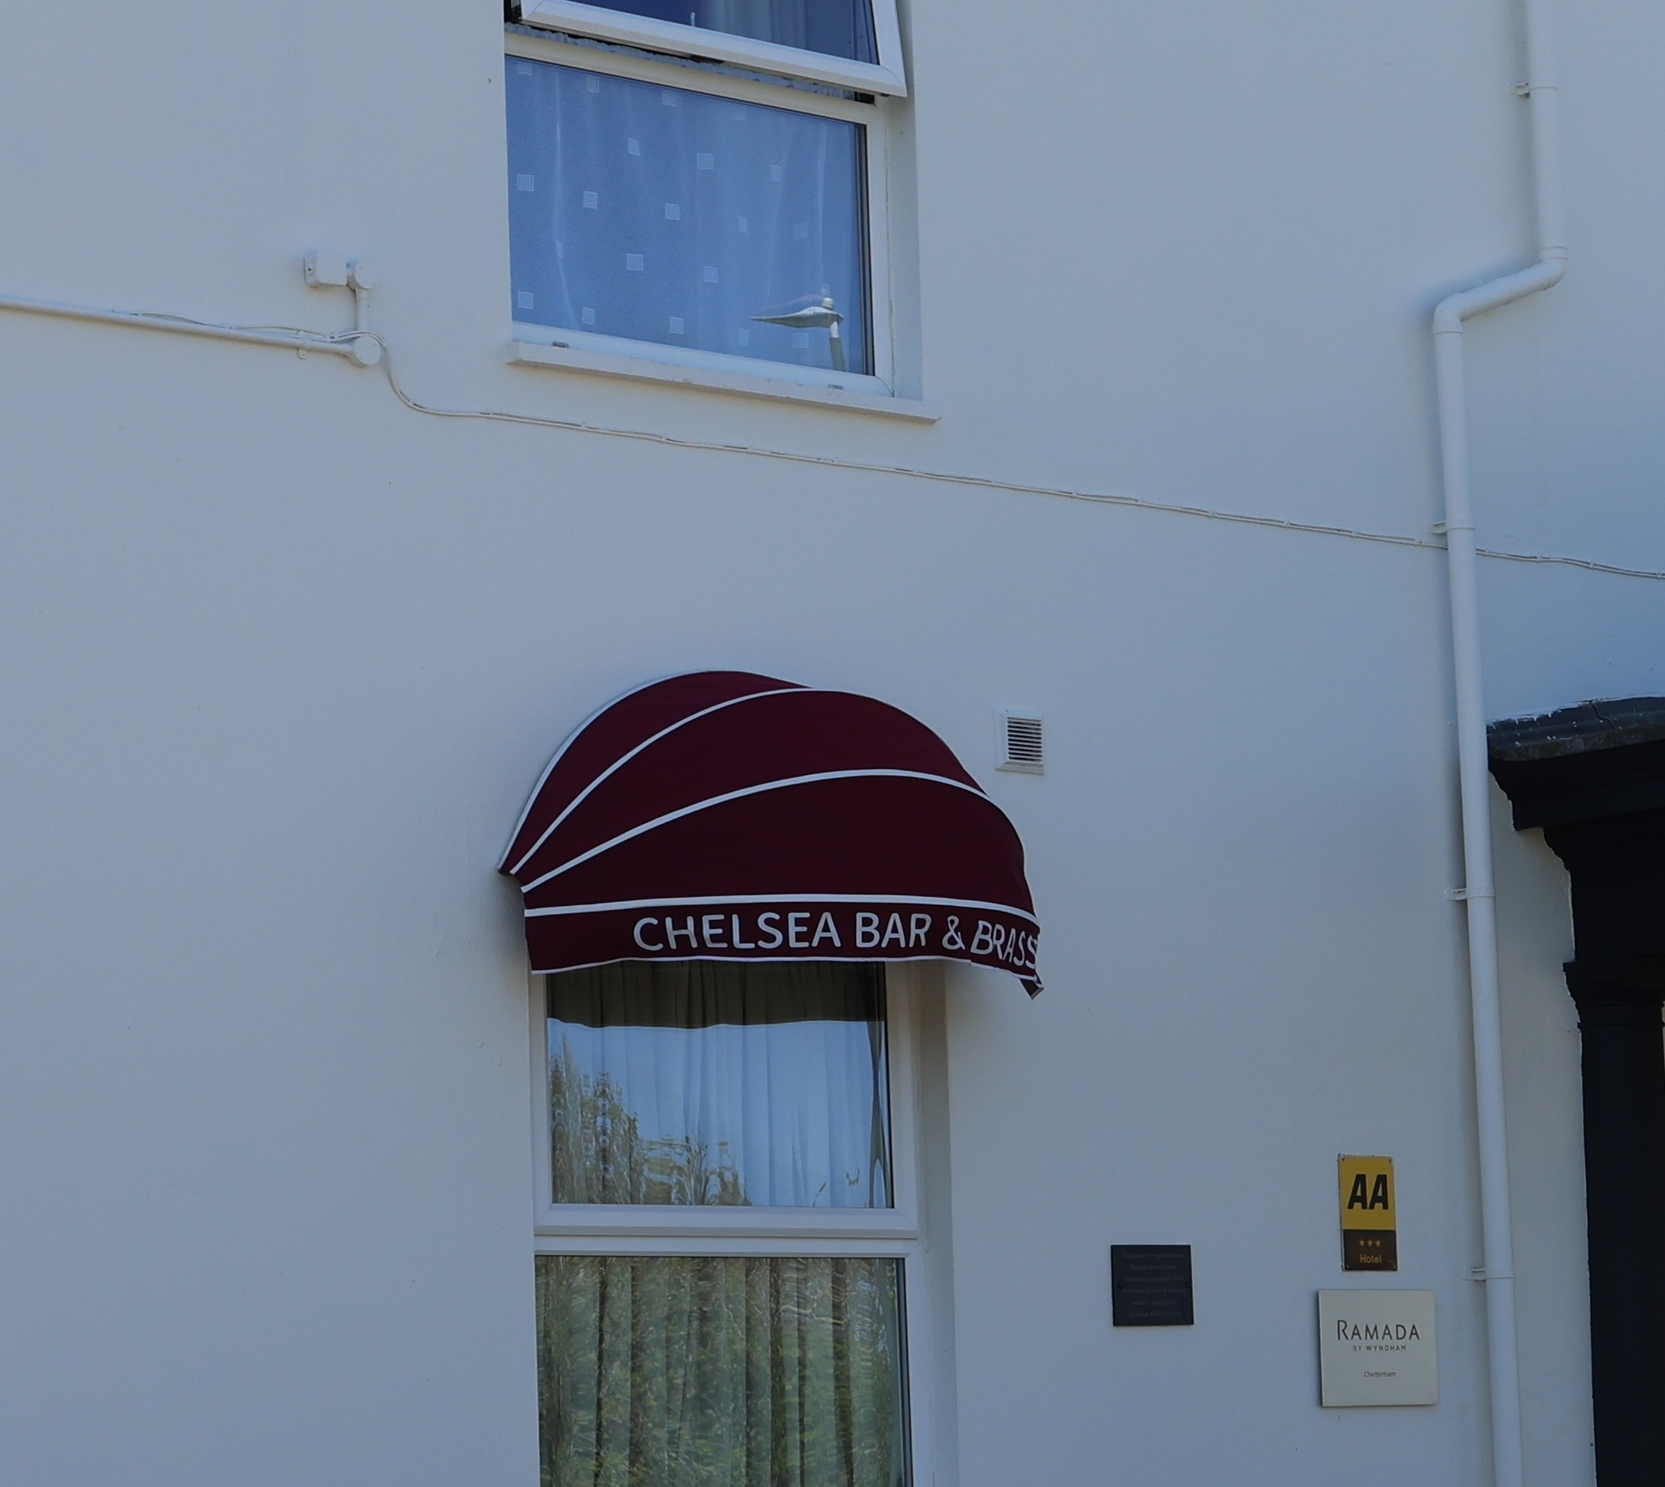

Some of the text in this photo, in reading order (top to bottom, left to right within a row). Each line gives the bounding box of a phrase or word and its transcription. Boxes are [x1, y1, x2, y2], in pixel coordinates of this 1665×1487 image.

[633, 911, 842, 951] CHELSEA
[855, 911, 931, 948] BAR
[941, 915, 966, 951] &
[1347, 1174, 1389, 1210] AA
[1359, 1254, 1383, 1264] Hotel
[1337, 1319, 1420, 1341] RAMADA
[1363, 1371, 1397, 1379] Cheltenham
